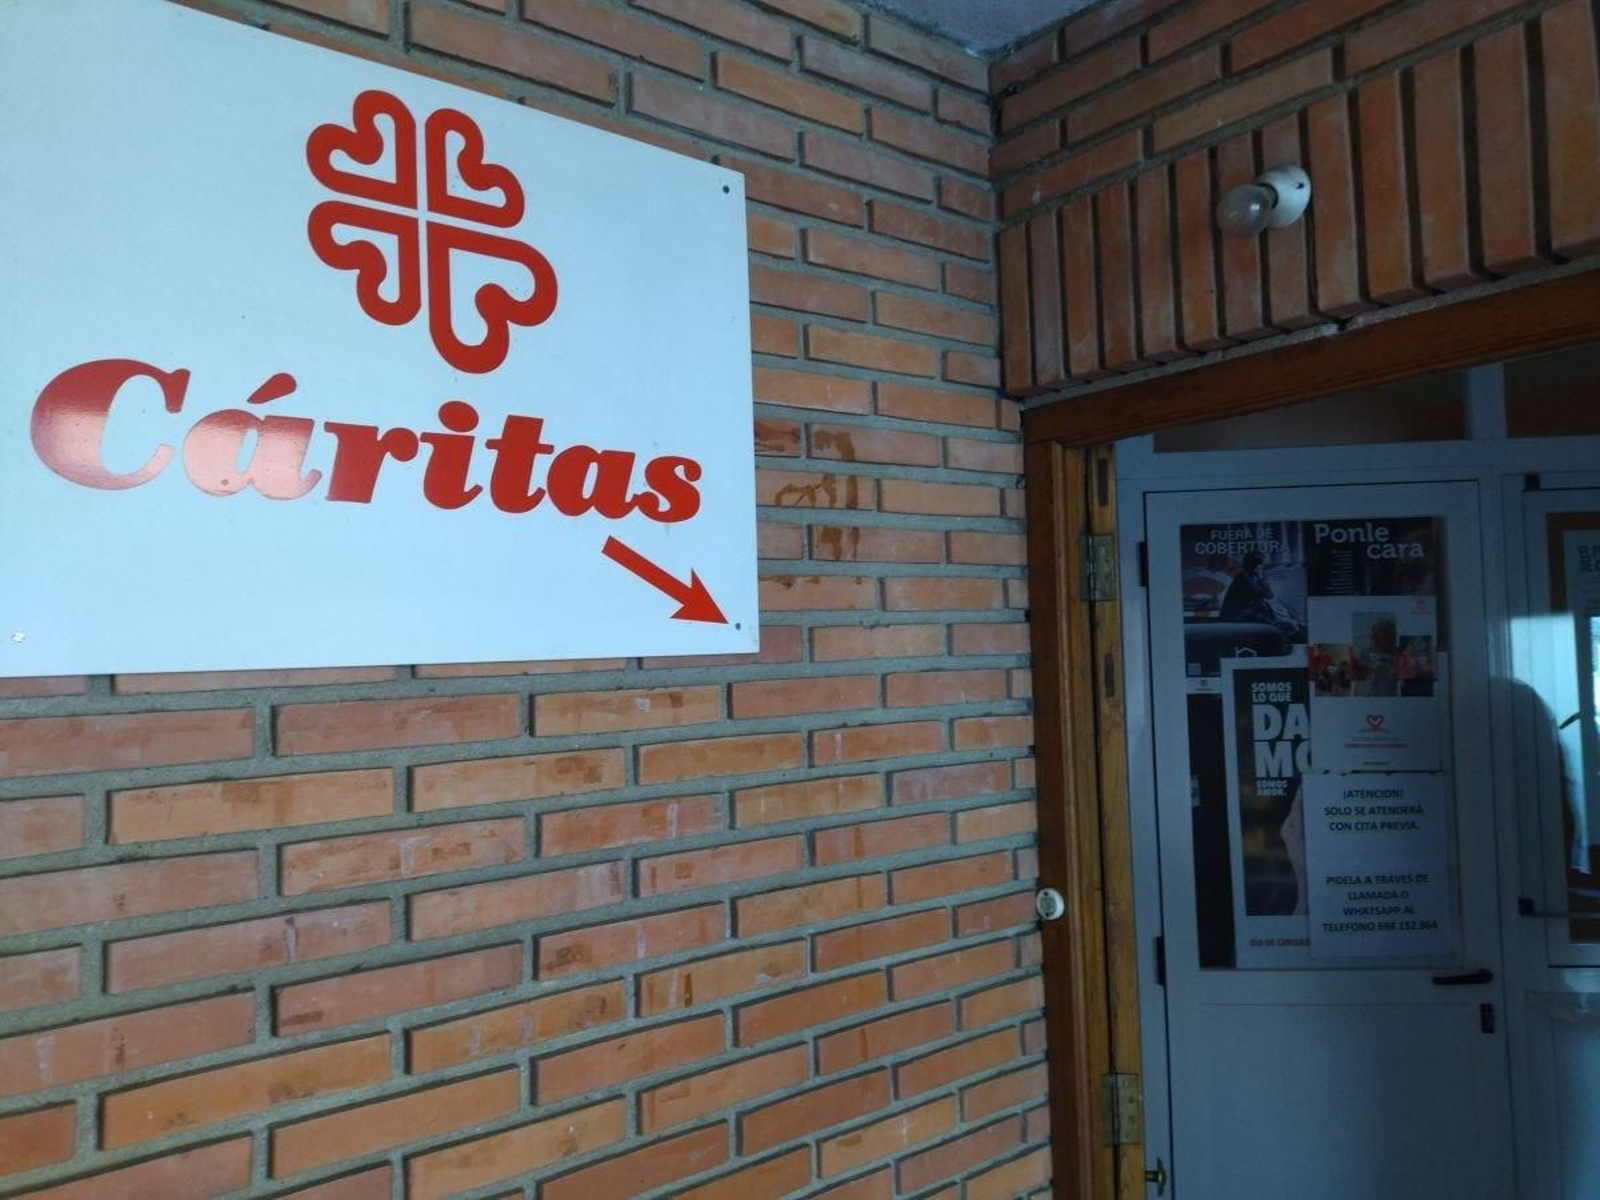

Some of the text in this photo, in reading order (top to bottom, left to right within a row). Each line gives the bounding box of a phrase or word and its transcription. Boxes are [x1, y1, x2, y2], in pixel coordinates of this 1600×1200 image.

[30, 357, 702, 523] Cáritas
[1210, 529, 1253, 541] FUERA
[1313, 521, 1390, 545] Ponle
[1366, 542, 1425, 560] cara
[1251, 682, 1292, 693] SOMOS
[1252, 692, 1292, 703] LO QUE
[1256, 779, 1288, 789] SOMOS
[1324, 805, 1353, 816] SOLO
[1354, 805, 1367, 816] SE
[1329, 821, 1352, 832] CON
[1354, 821, 1378, 831] CITA
[1365, 875, 1373, 885] A
[1415, 873, 1430, 884] DE
[1348, 889, 1409, 901] LLAMADA O
[1343, 905, 1416, 916] WHATSAPP AL
